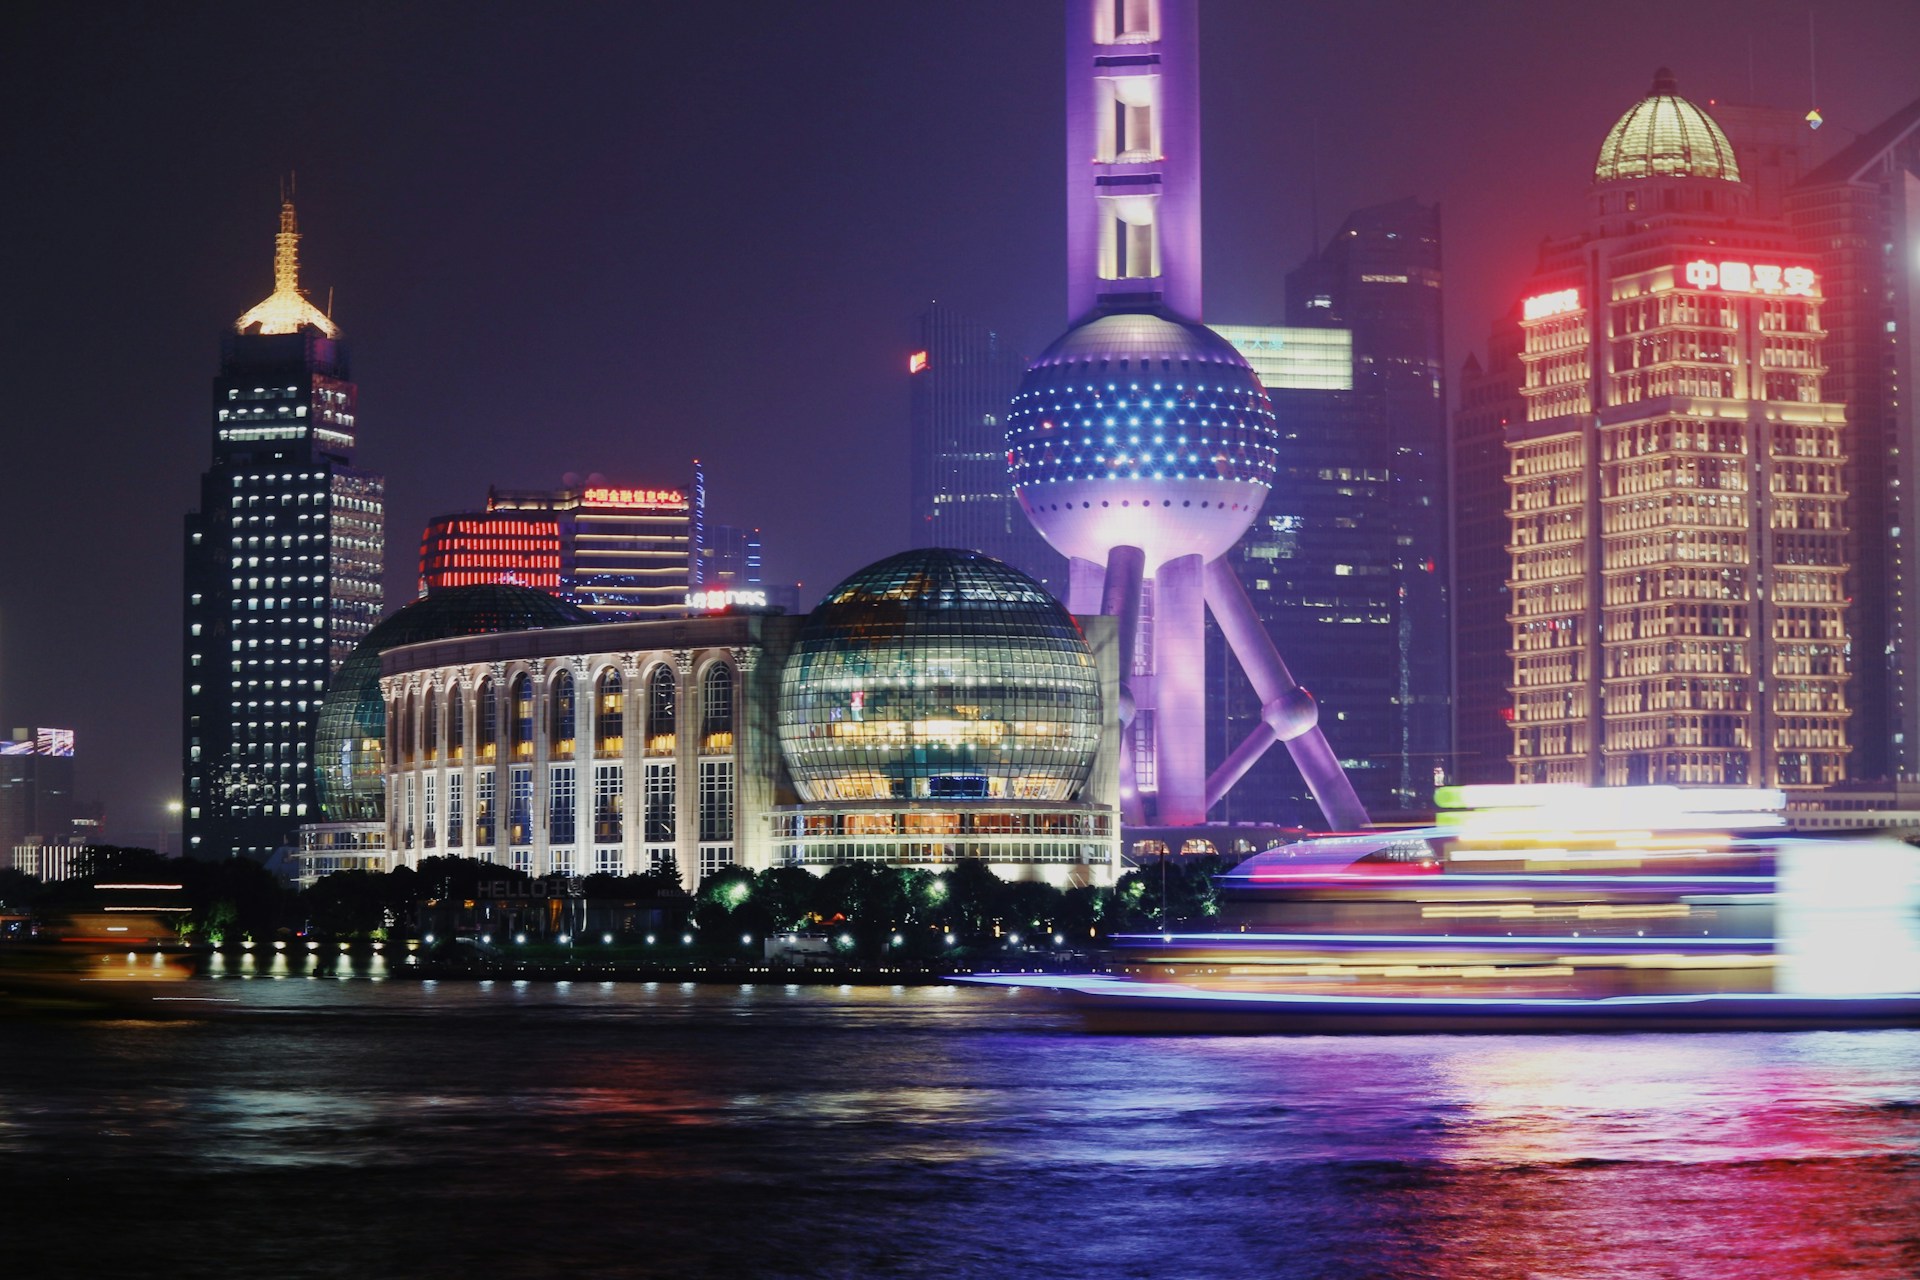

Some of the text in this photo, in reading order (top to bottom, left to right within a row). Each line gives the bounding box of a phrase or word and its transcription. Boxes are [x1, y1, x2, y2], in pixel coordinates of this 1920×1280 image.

[584, 488, 682, 503] 中国金融信息中心
